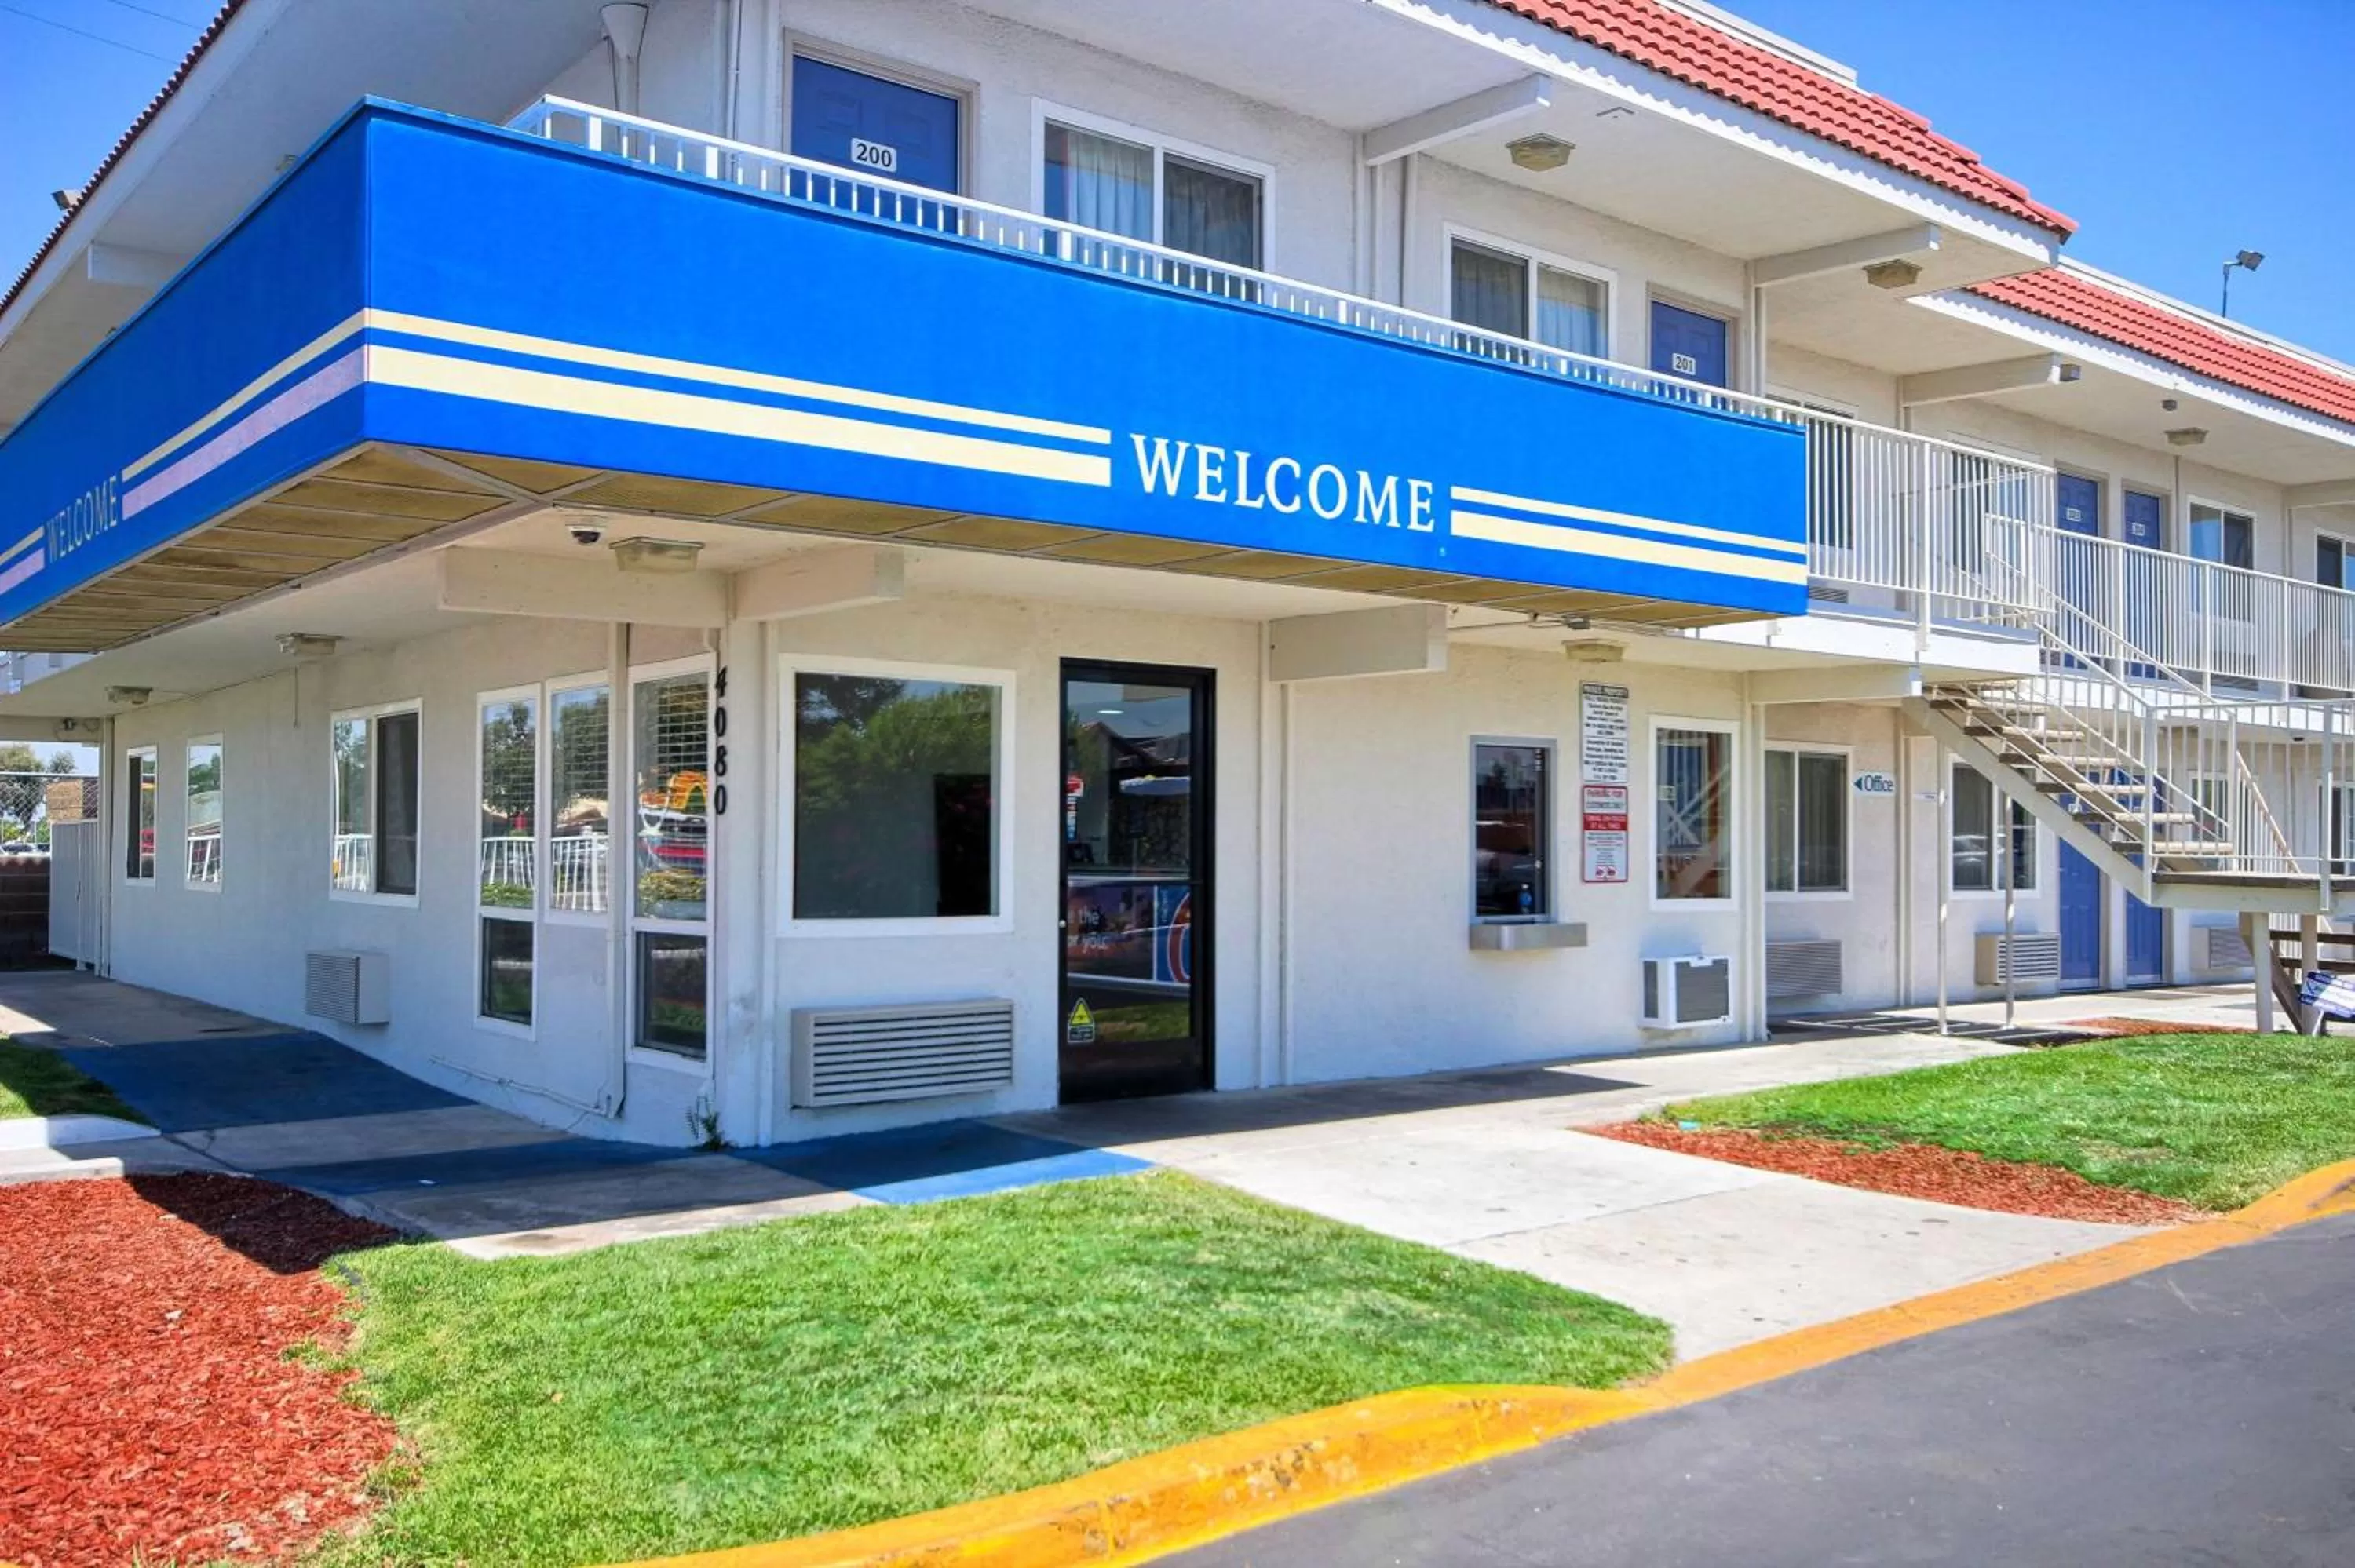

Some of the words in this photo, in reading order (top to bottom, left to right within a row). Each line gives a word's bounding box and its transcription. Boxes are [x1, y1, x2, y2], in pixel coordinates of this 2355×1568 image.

[856, 142, 892, 167] 200
[1675, 356, 1693, 372] 201
[1130, 432, 1436, 533] WELCOME
[47, 475, 117, 564] WELCOME
[714, 665, 728, 815] 4080
[1864, 774, 1894, 793] Office
